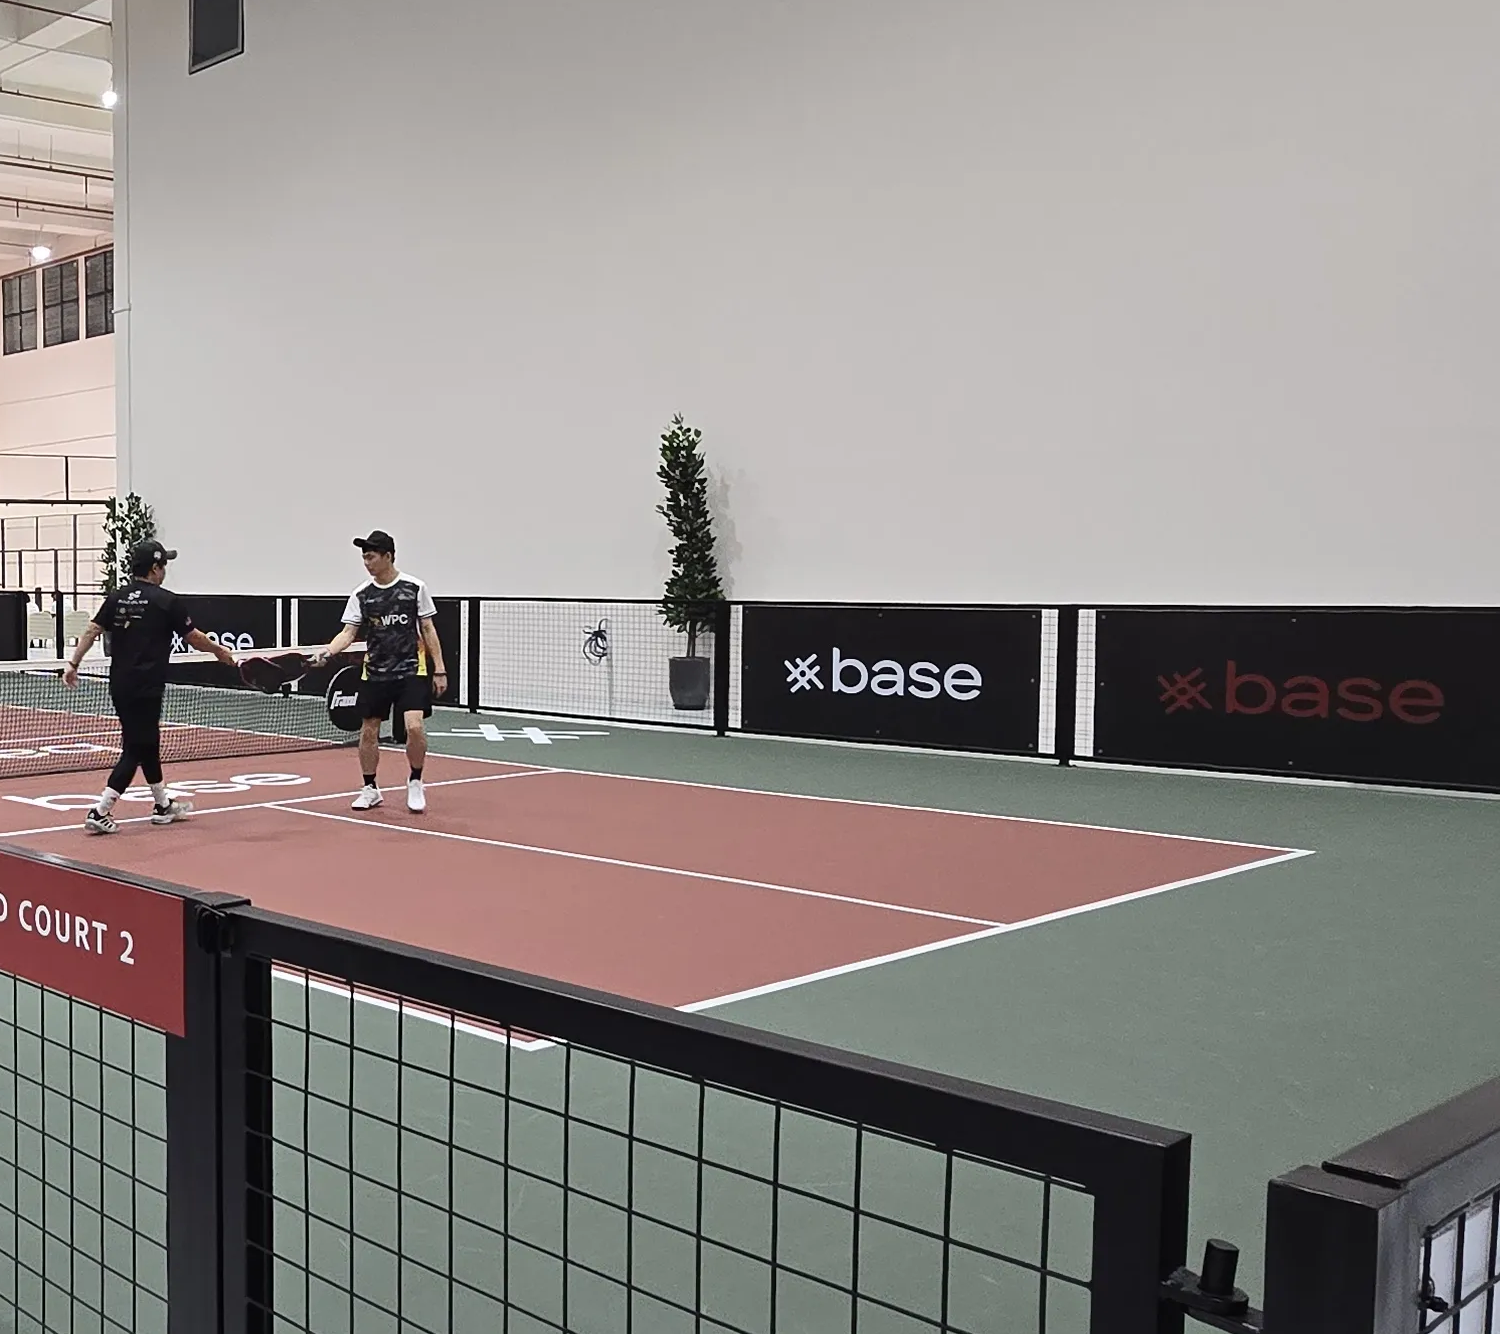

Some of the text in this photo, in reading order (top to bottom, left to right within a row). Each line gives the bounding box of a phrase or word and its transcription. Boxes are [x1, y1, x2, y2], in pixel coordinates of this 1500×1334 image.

[381, 614, 409, 627] WPC
[832, 647, 983, 701] base
[1226, 660, 1445, 724] base
[18, 900, 108, 955] COURT
[119, 930, 135, 965] 2
